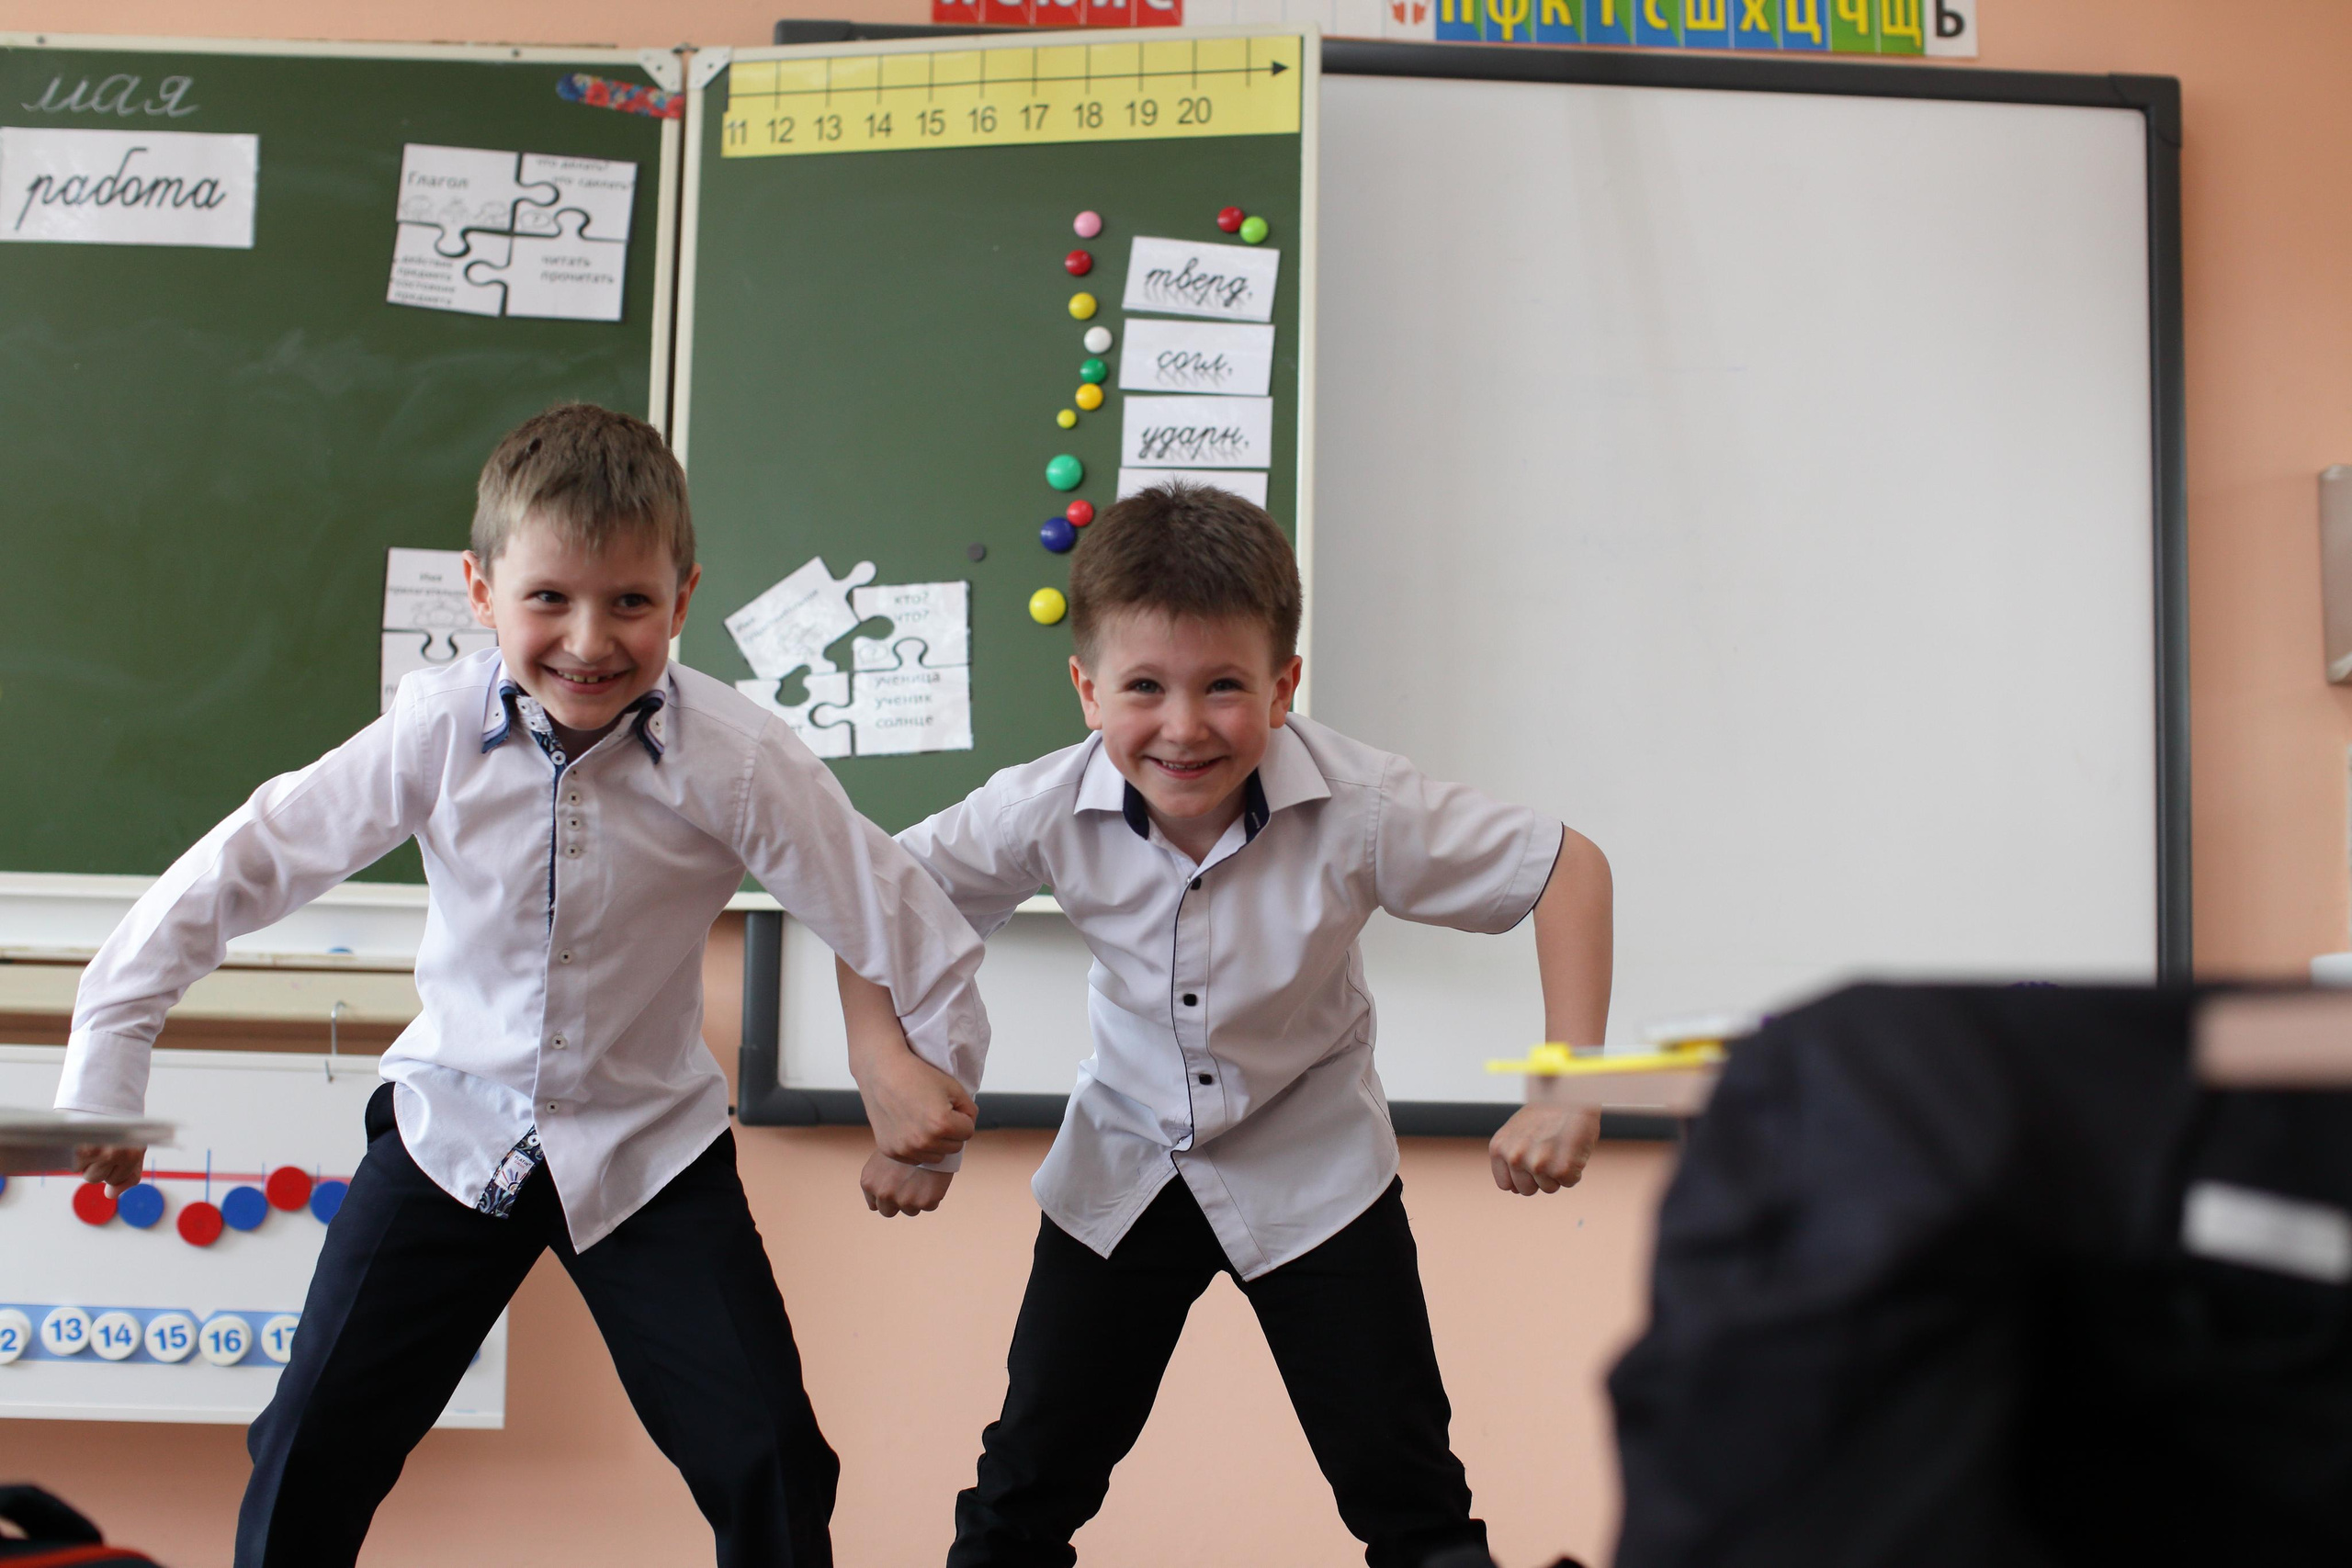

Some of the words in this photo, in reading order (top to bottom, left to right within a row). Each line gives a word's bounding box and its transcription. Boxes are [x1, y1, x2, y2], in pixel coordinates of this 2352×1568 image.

[20, 73, 200, 118] мая
[727, 119, 748, 145] 11
[765, 117, 796, 143] 12
[813, 114, 843, 141] 13
[864, 111, 893, 139] 14
[915, 108, 946, 137] 15
[967, 106, 998, 133] 16
[1019, 103, 1051, 131] 17
[1072, 101, 1104, 130] 18
[1124, 98, 1159, 127] 19
[1176, 96, 1214, 125] 20
[15, 146, 228, 232] работа
[407, 171, 469, 189] Глагол
[1138, 425, 1250, 459] ударн.
[875, 694, 932, 709] ученик
[876, 716, 933, 729] солнце
[0, 1328, 17, 1352] 2
[50, 1317, 83, 1342] 13
[98, 1324, 132, 1348] 14
[153, 1325, 187, 1350] 15
[209, 1328, 242, 1353] 16
